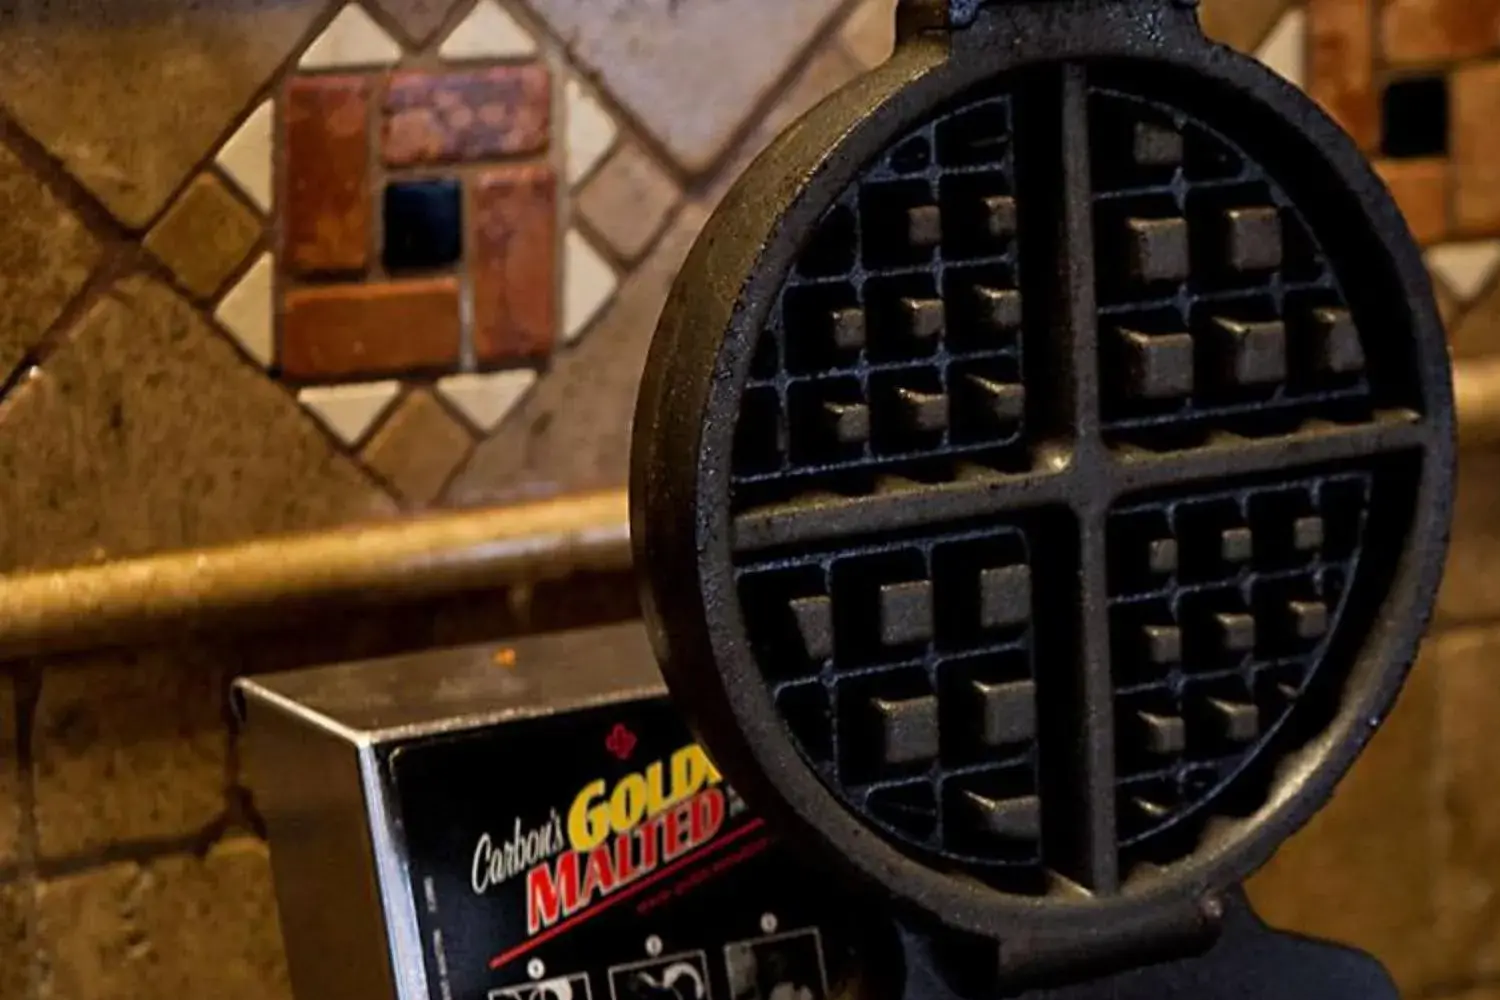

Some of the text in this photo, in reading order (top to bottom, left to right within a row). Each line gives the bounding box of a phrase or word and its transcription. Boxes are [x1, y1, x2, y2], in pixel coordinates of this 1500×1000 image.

[471, 807, 564, 894] Carbon's
[567, 743, 722, 852] GOLD
[527, 786, 725, 935] MALTED
